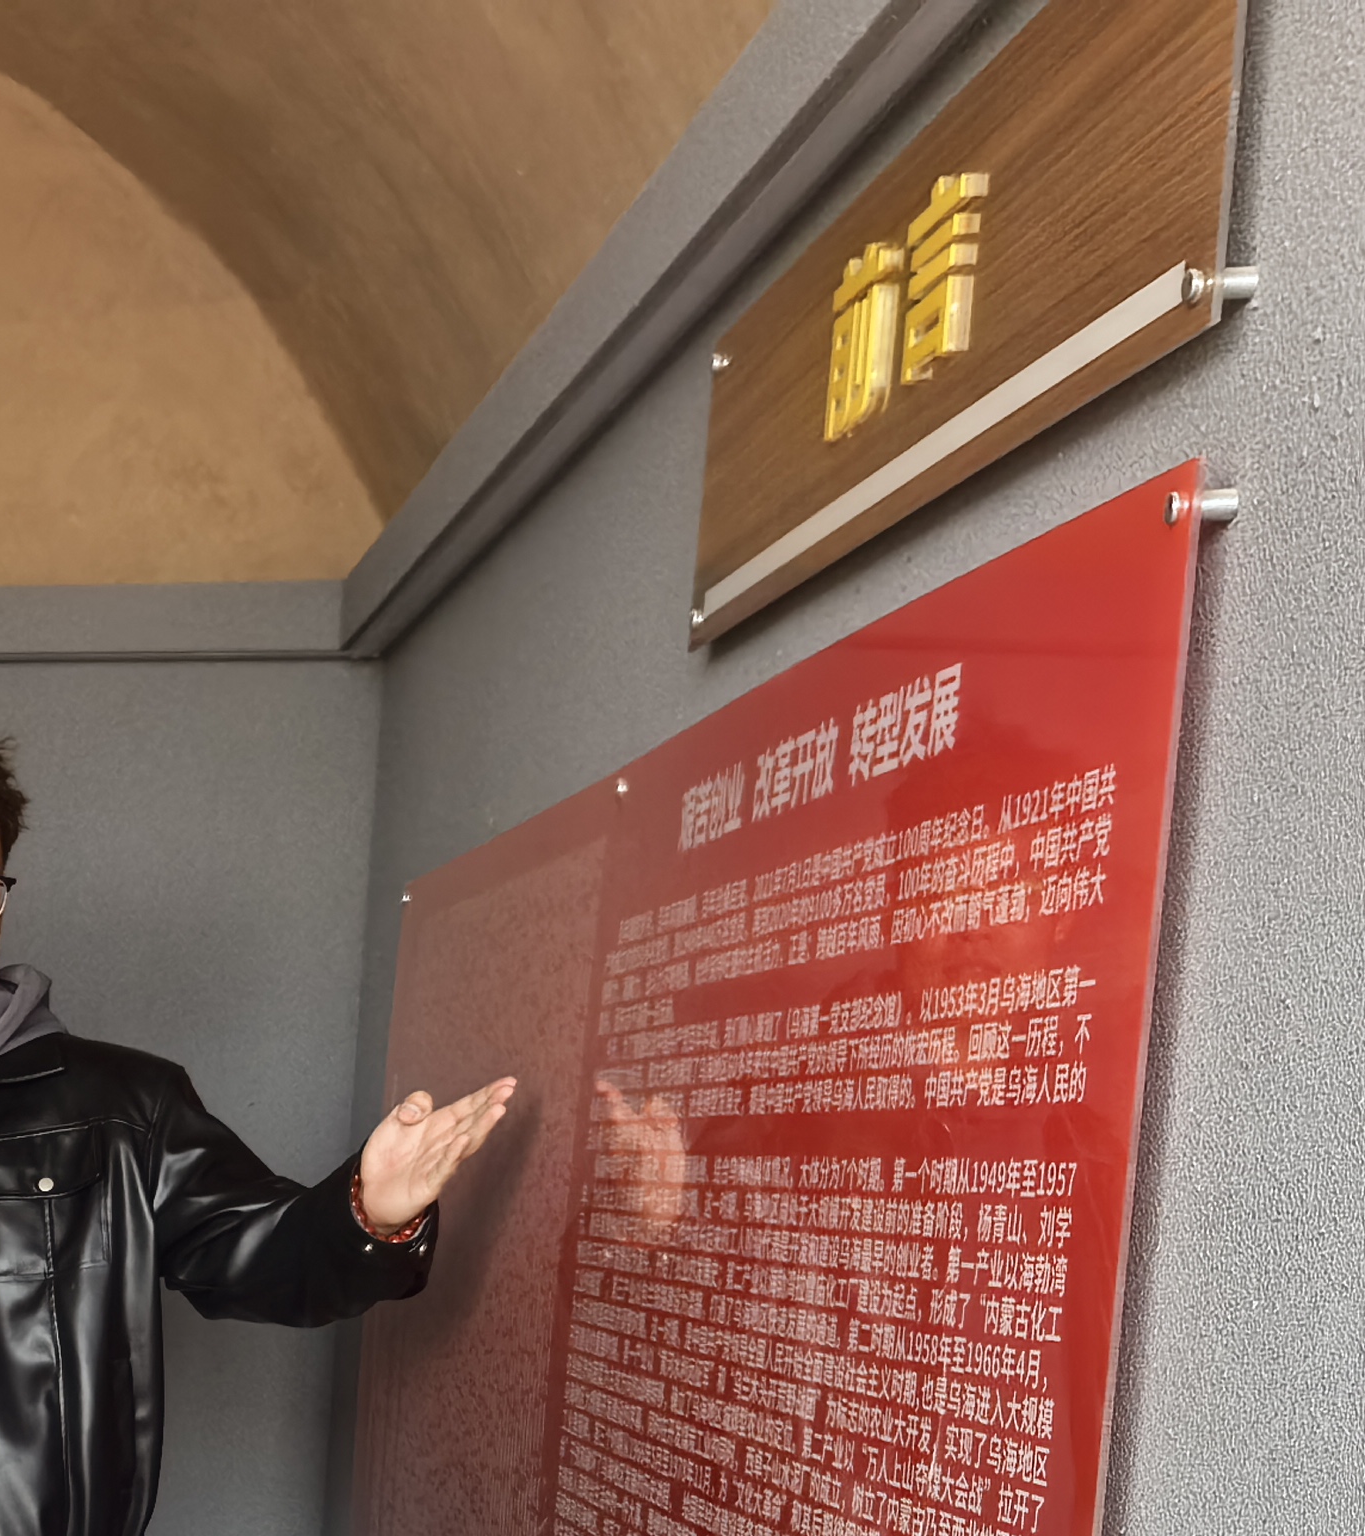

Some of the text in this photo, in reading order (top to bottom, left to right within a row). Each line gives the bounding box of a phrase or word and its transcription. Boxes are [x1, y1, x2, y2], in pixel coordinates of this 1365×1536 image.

[824, 171, 991, 442] 前言
[752, 716, 839, 823] 改革开放
[849, 662, 962, 787] 转型发展
